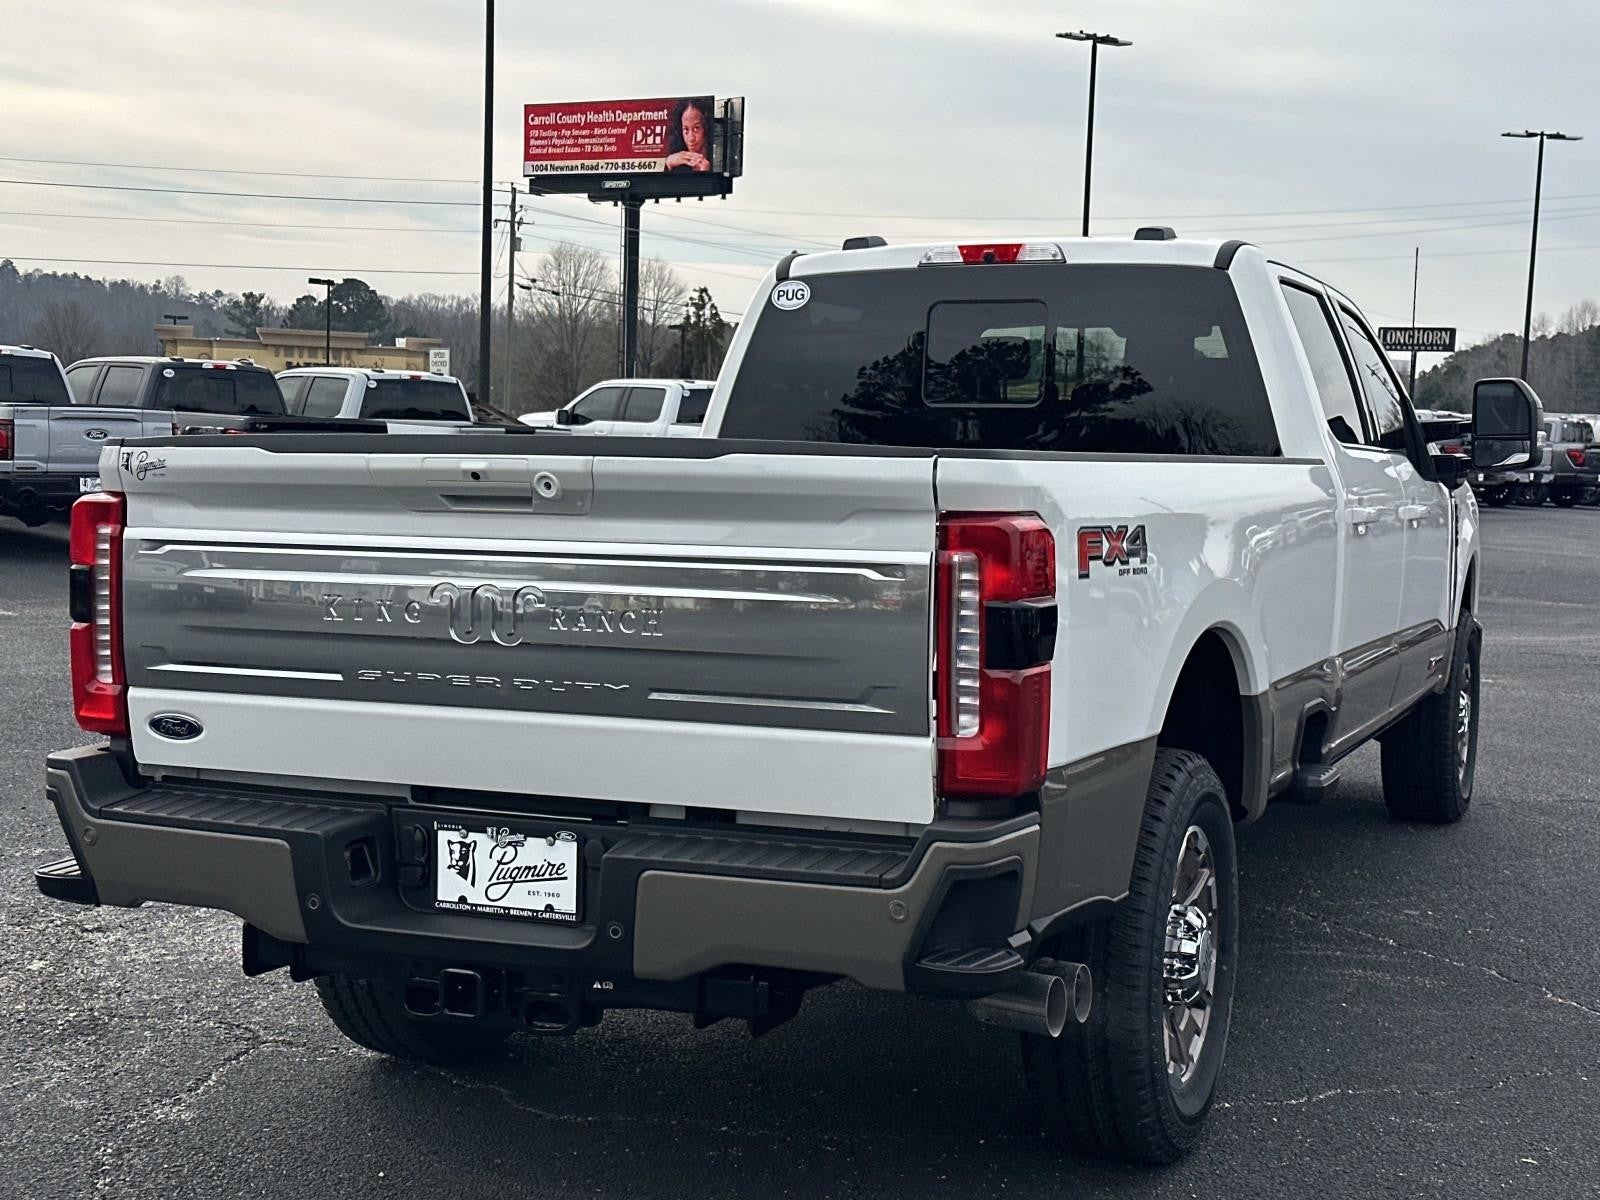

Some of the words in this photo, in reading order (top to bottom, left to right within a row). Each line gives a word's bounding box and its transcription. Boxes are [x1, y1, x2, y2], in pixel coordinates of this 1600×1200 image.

[529, 112, 555, 125] Carroll
[557, 112, 586, 126] County
[587, 110, 614, 122] Health
[616, 109, 668, 124] Department
[561, 129, 571, 137] Pap
[594, 127, 607, 135] Birth
[608, 126, 627, 134] Control
[632, 125, 666, 145] DPH
[552, 137, 574, 146] Physicals
[578, 136, 616, 144] Immunizations
[531, 164, 548, 172] 1004
[550, 163, 578, 172] Newnan
[581, 162, 599, 171] Road
[605, 161, 657, 171] 770-836-6667
[777, 289, 805, 301] PUG
[1380, 329, 1450, 345] LONGHORN
[136, 451, 167, 480] Pugmire
[1077, 525, 1147, 579] FX4
[1119, 568, 1130, 576] OFF
[1133, 567, 1147, 575] ROAD
[323, 594, 421, 623] KING
[549, 606, 664, 636] RANCH
[358, 669, 501, 687] SUPER
[513, 678, 629, 690] DUTY
[485, 845, 568, 902] Pugmire
[435, 902, 471, 910] CARROLLTON
[477, 905, 504, 914] MARIETTA
[509, 908, 532, 917] BREMEN
[538, 911, 576, 921] CARTERSVILLE
